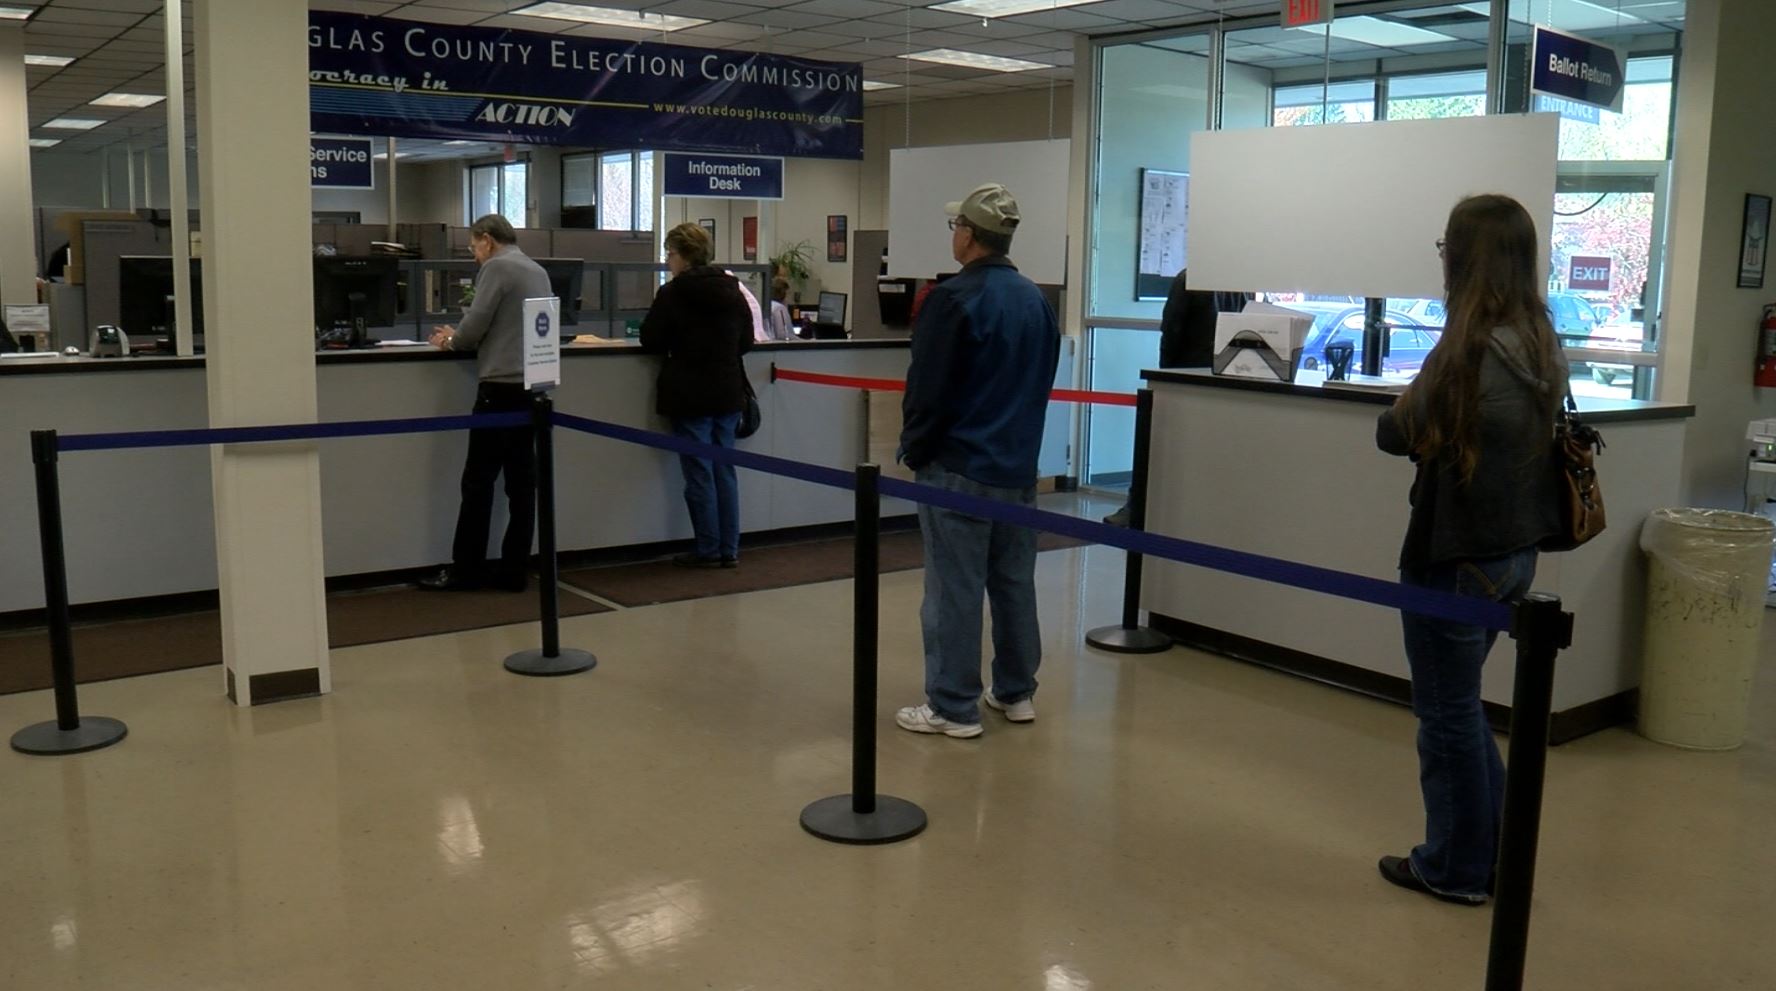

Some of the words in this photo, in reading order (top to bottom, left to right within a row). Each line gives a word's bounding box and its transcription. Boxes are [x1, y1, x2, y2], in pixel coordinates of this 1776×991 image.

[1548, 53, 1579, 78] Ballot
[1580, 62, 1612, 87] Return
[421, 72, 449, 91] in
[475, 101, 576, 127] ACTION
[653, 101, 844, 125] www.votedouglascounty.com
[1540, 95, 1594, 119] ENTRANCE
[688, 160, 761, 177] Information
[709, 176, 742, 190] Desk
[1572, 266, 1609, 281] EXIT
